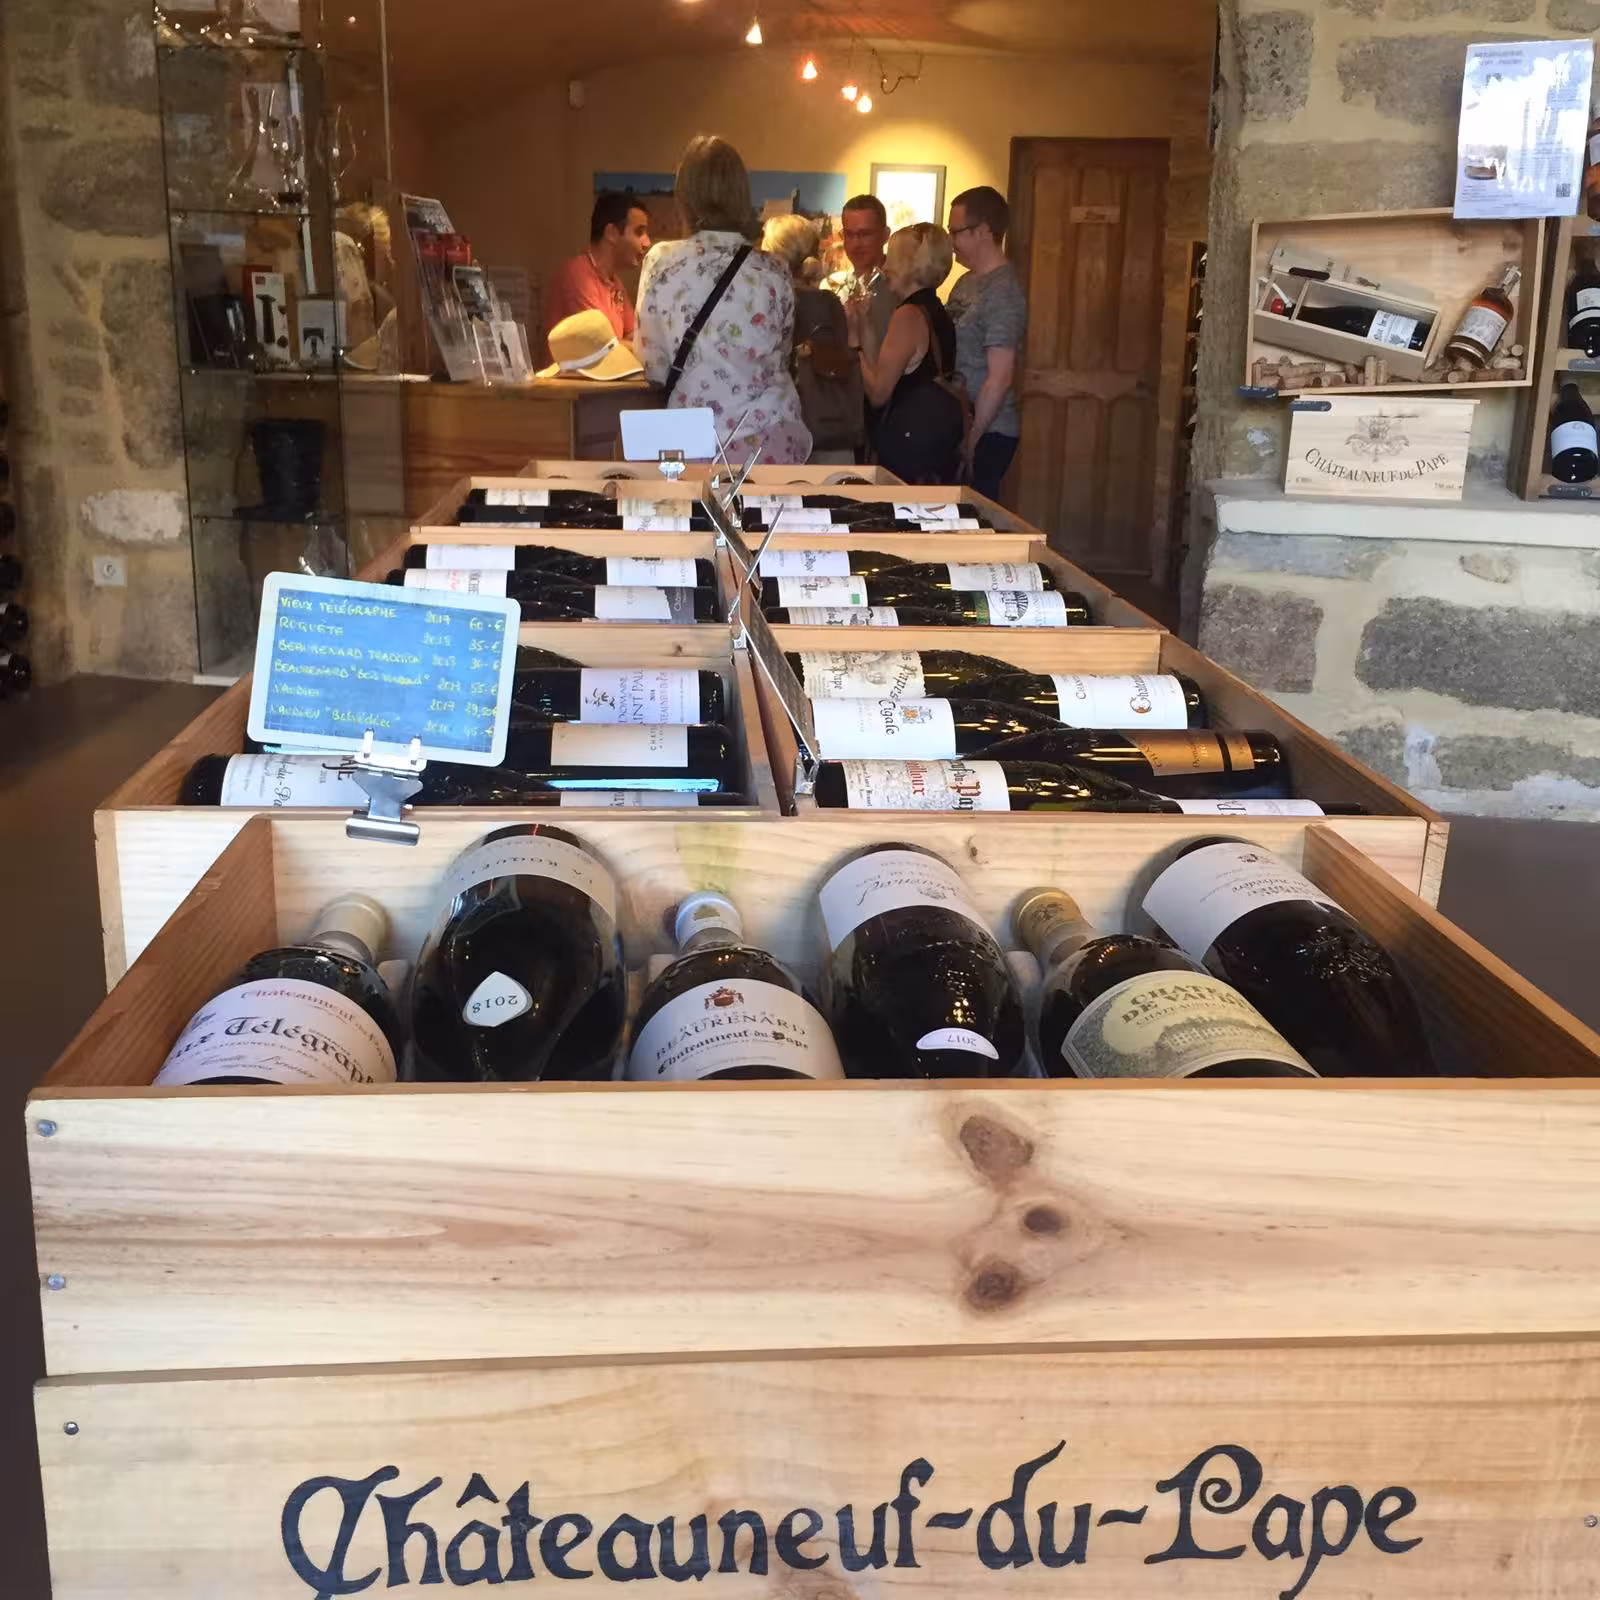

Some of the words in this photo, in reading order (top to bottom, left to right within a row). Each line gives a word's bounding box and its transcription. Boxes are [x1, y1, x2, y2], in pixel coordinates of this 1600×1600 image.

[472, 994, 518, 1014] 2018
[1121, 1000, 1159, 1024] DE
[655, 1014, 807, 1060] BEAURENARD
[281, 1439, 1424, 1600] Châteauneuf-du-Pape
